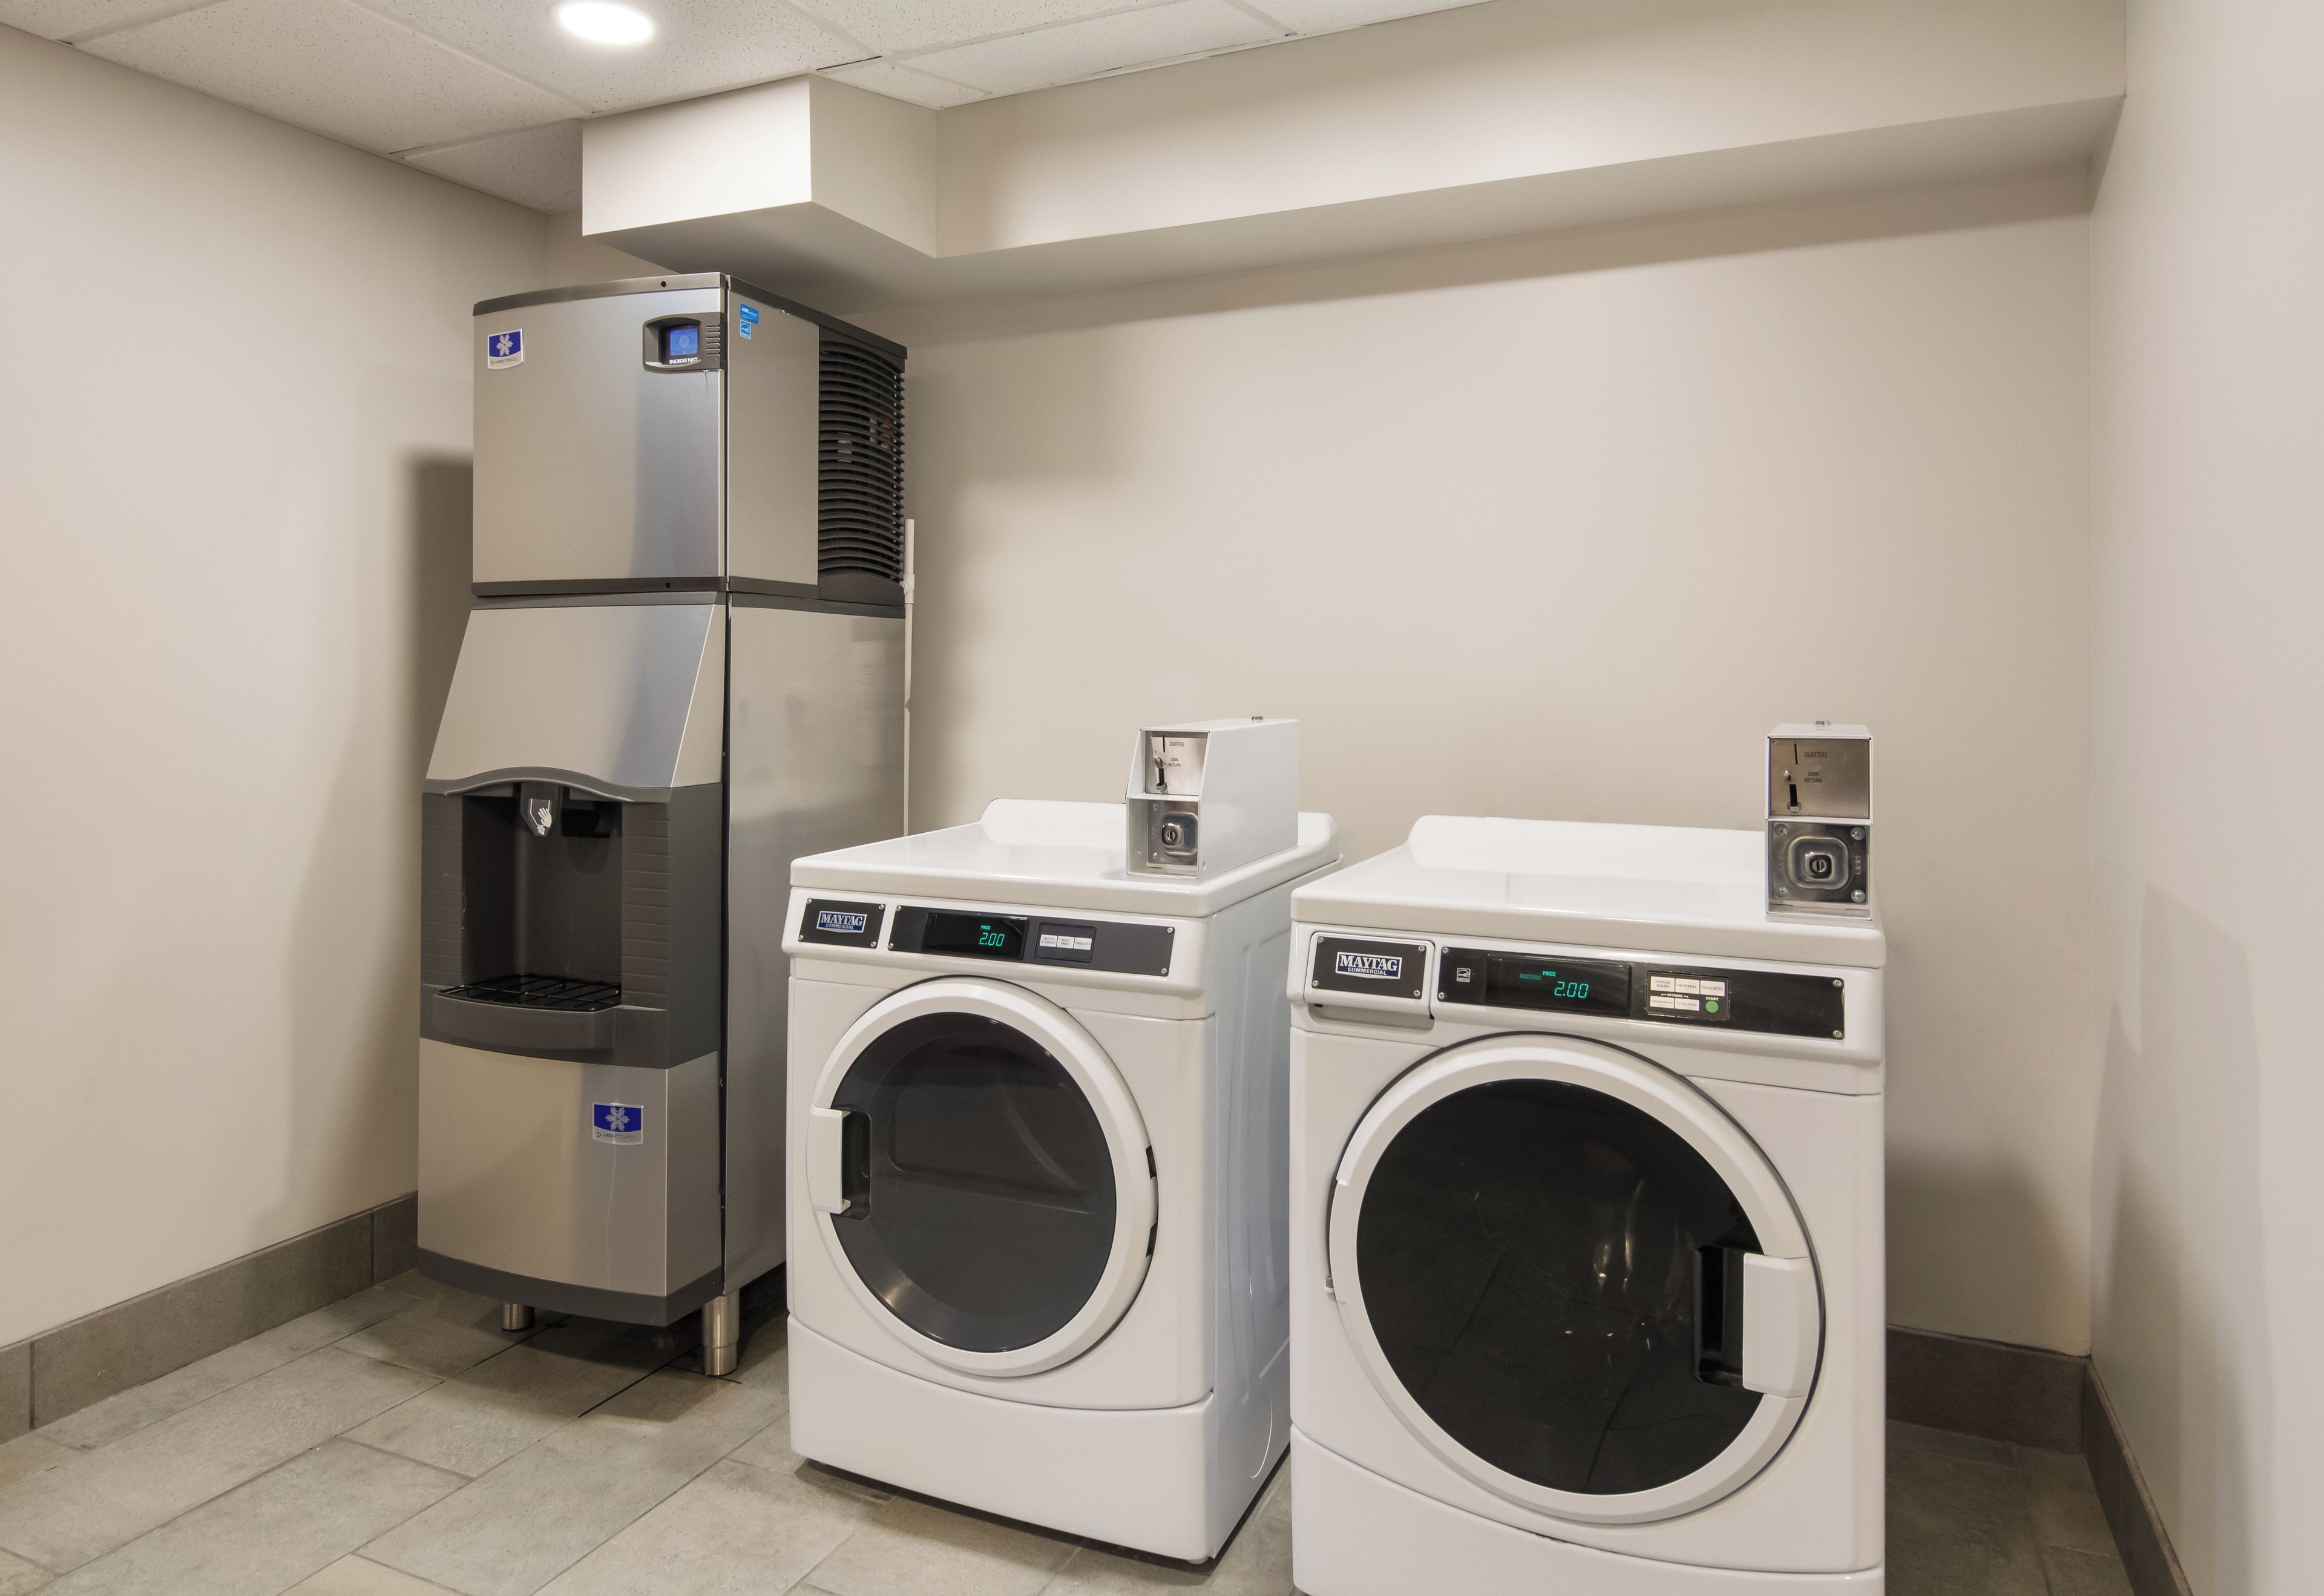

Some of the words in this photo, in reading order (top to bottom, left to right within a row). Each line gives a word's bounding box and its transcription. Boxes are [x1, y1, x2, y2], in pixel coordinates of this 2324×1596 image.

[820, 913, 863, 926] MAYTAG
[979, 933, 1005, 946] 2.00
[1339, 955, 1397, 971] MAYTAG
[1554, 981, 1589, 998] 2.00
